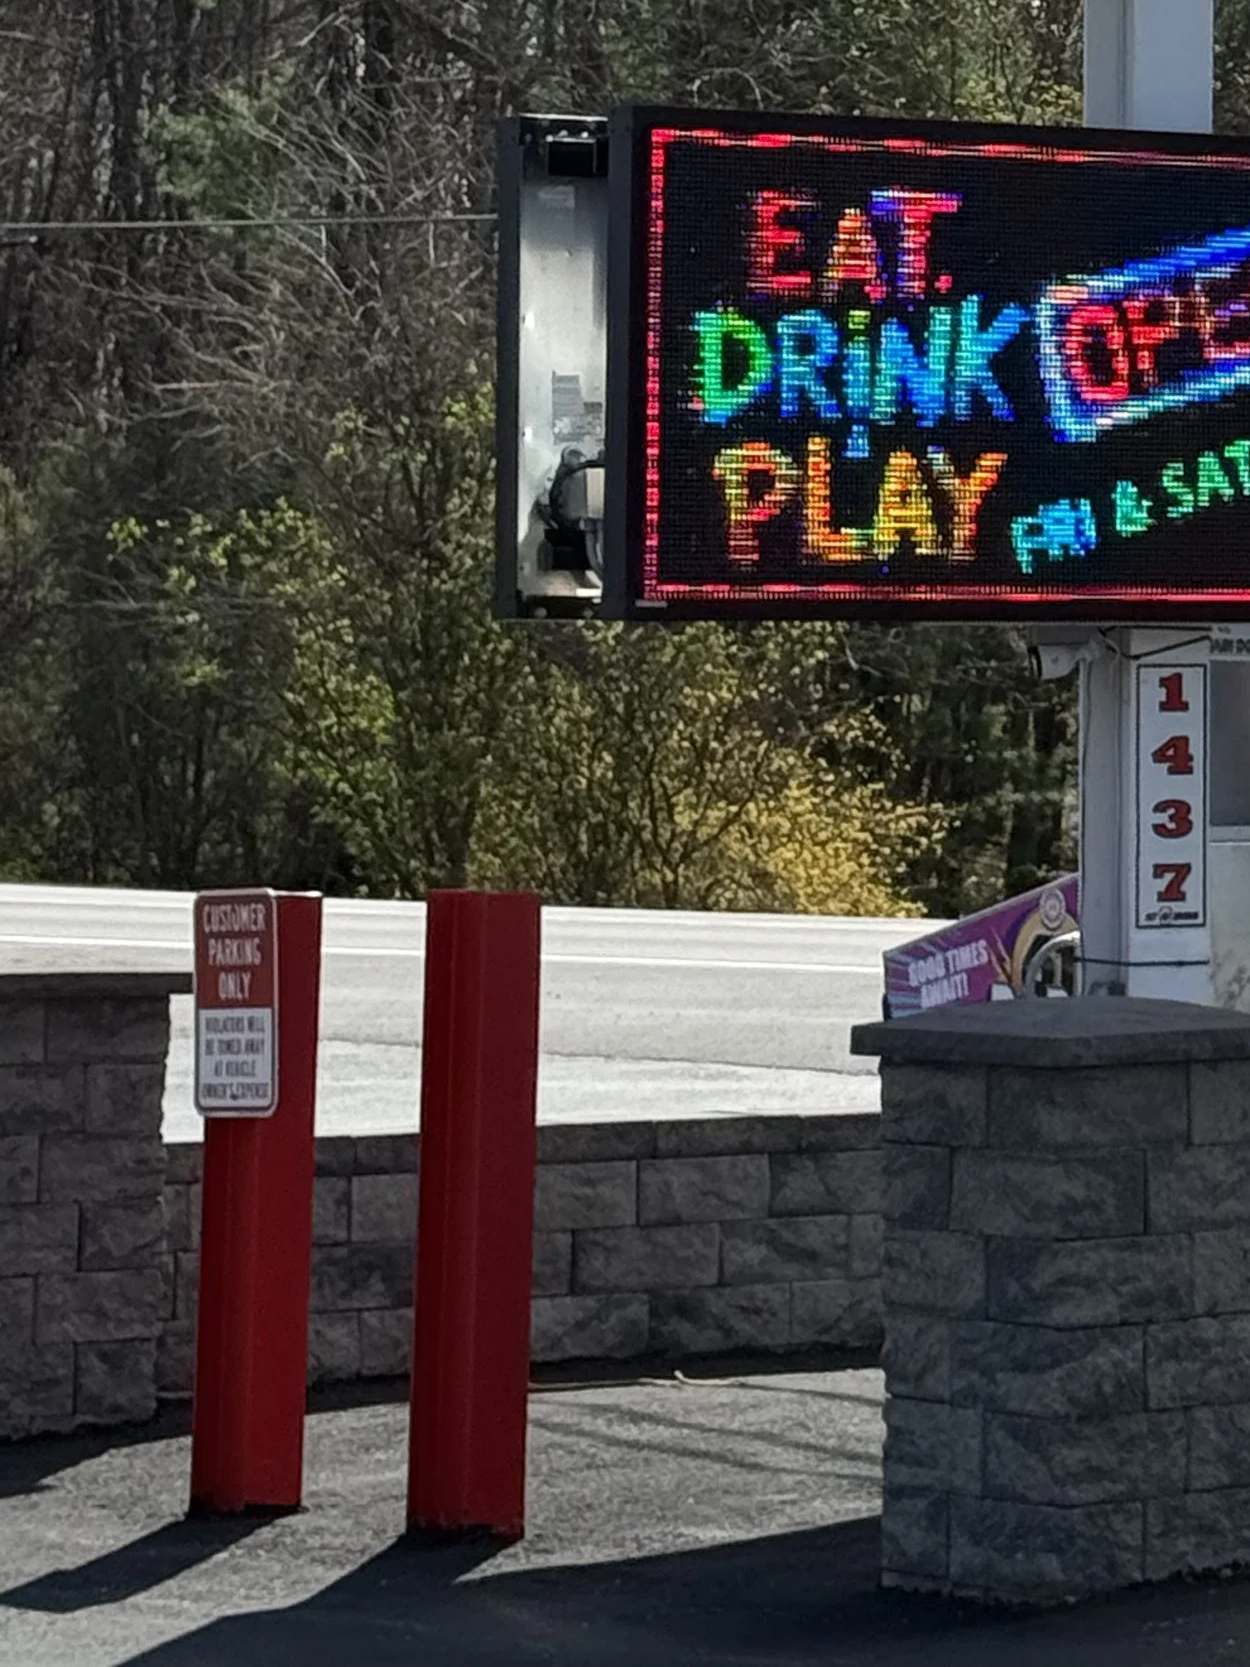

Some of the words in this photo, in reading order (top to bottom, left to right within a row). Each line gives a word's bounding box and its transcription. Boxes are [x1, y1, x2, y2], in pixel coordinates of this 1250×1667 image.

[712, 433, 1009, 570] PLAY
[203, 903, 266, 933] CUSTOMER
[208, 937, 262, 966] PARKING
[908, 950, 946, 988] GOOD
[946, 938, 989, 974] TIMES
[218, 971, 252, 1000] ONLY
